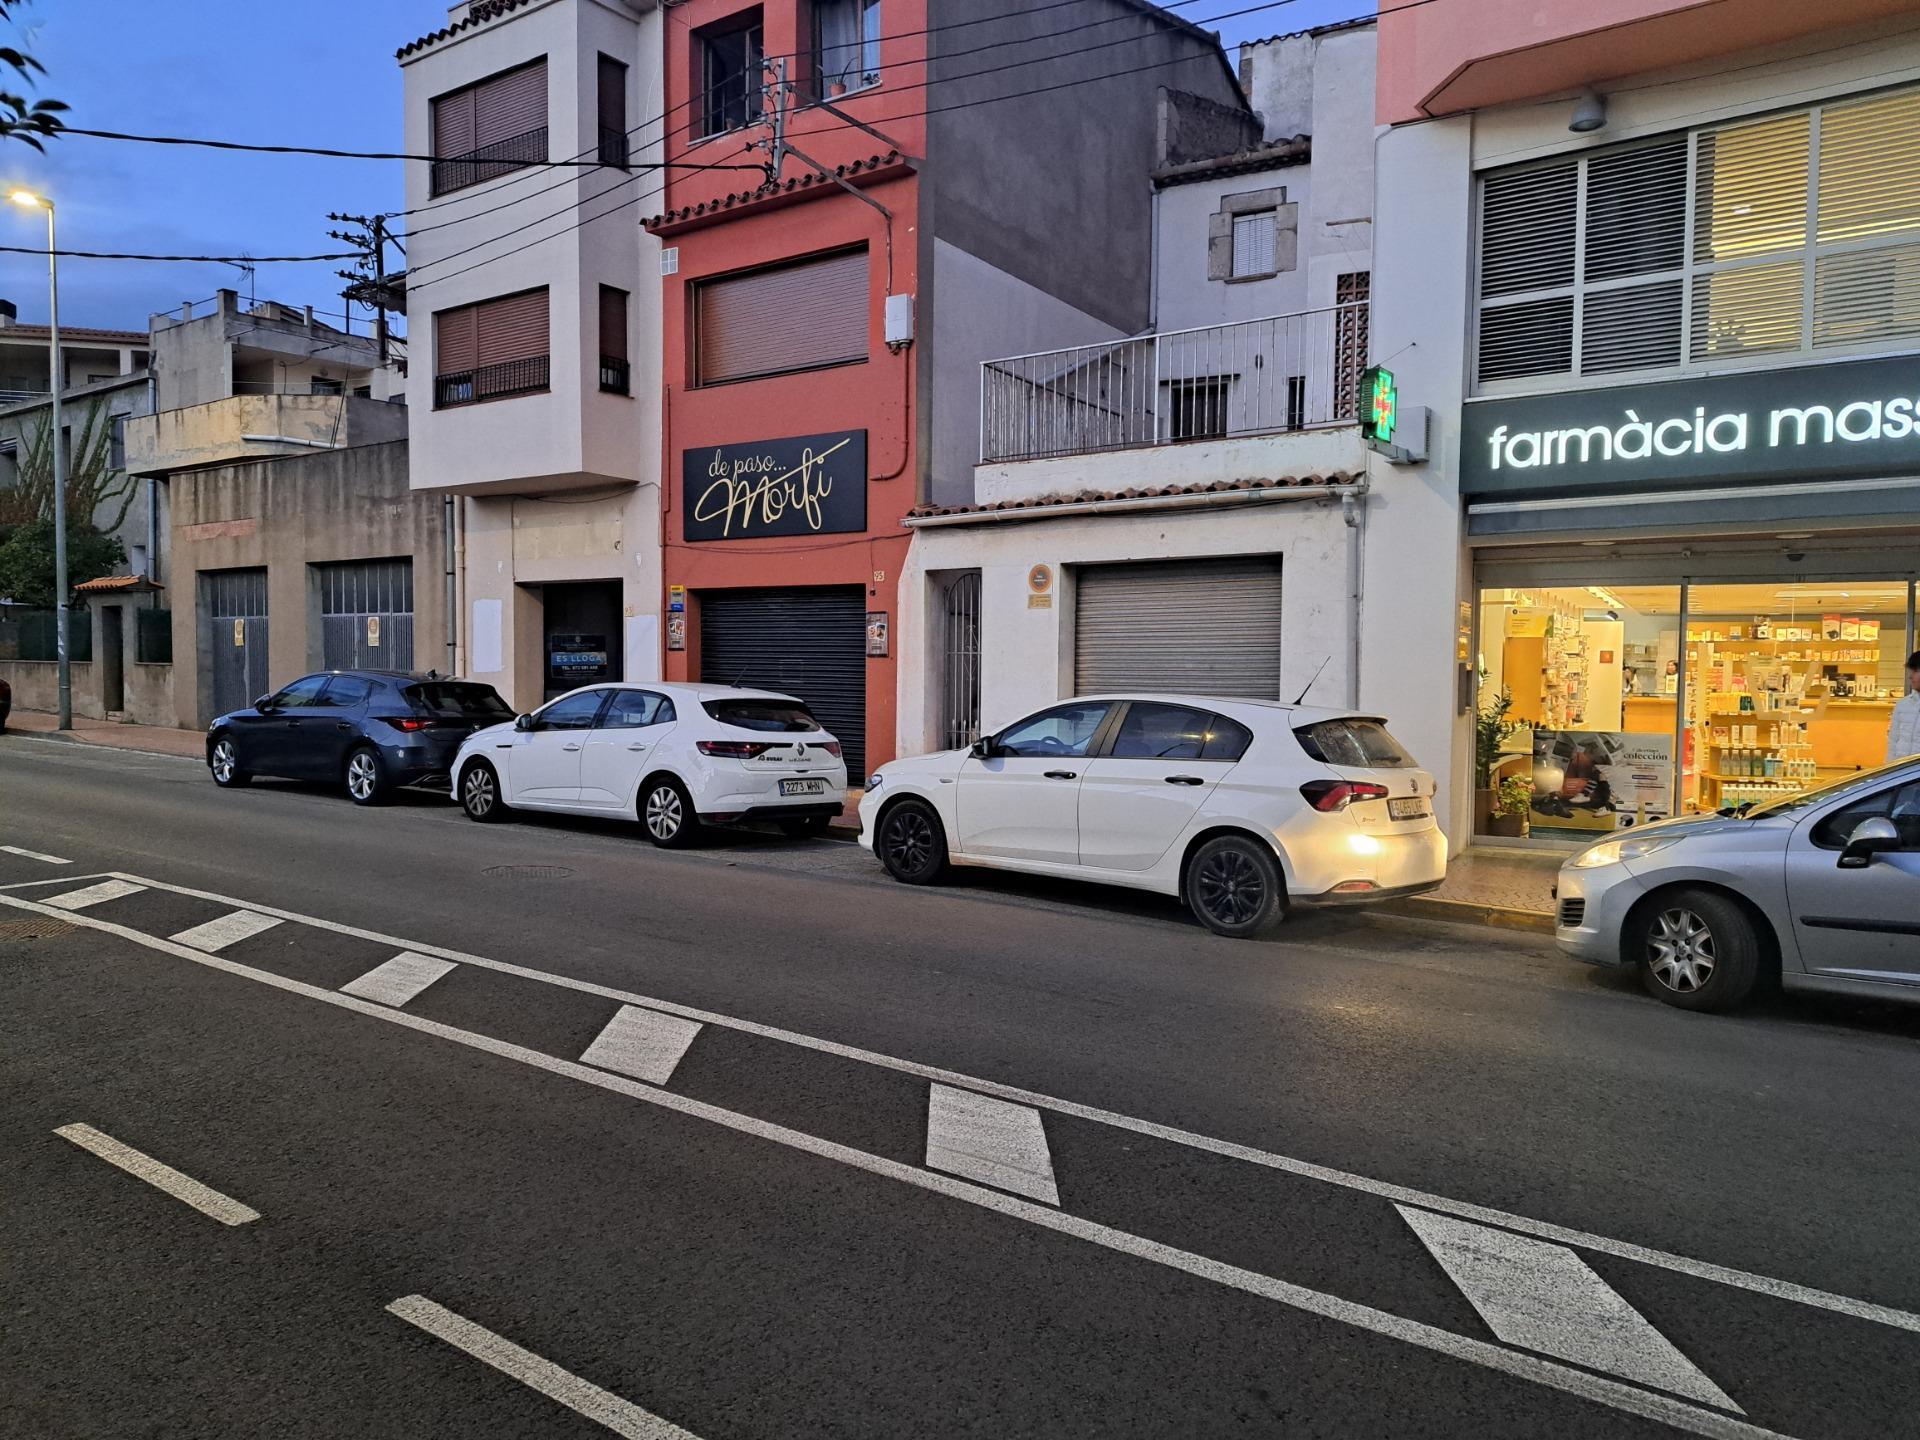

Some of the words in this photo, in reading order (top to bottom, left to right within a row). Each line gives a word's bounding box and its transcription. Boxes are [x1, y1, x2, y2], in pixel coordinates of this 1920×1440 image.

[1488, 406, 1748, 470] farmàcia
[1769, 396, 1920, 448] mas
[709, 449, 730, 477] de
[694, 438, 850, 537] Morfi
[1623, 752, 1668, 761] colección
[785, 781, 805, 792] 2273
